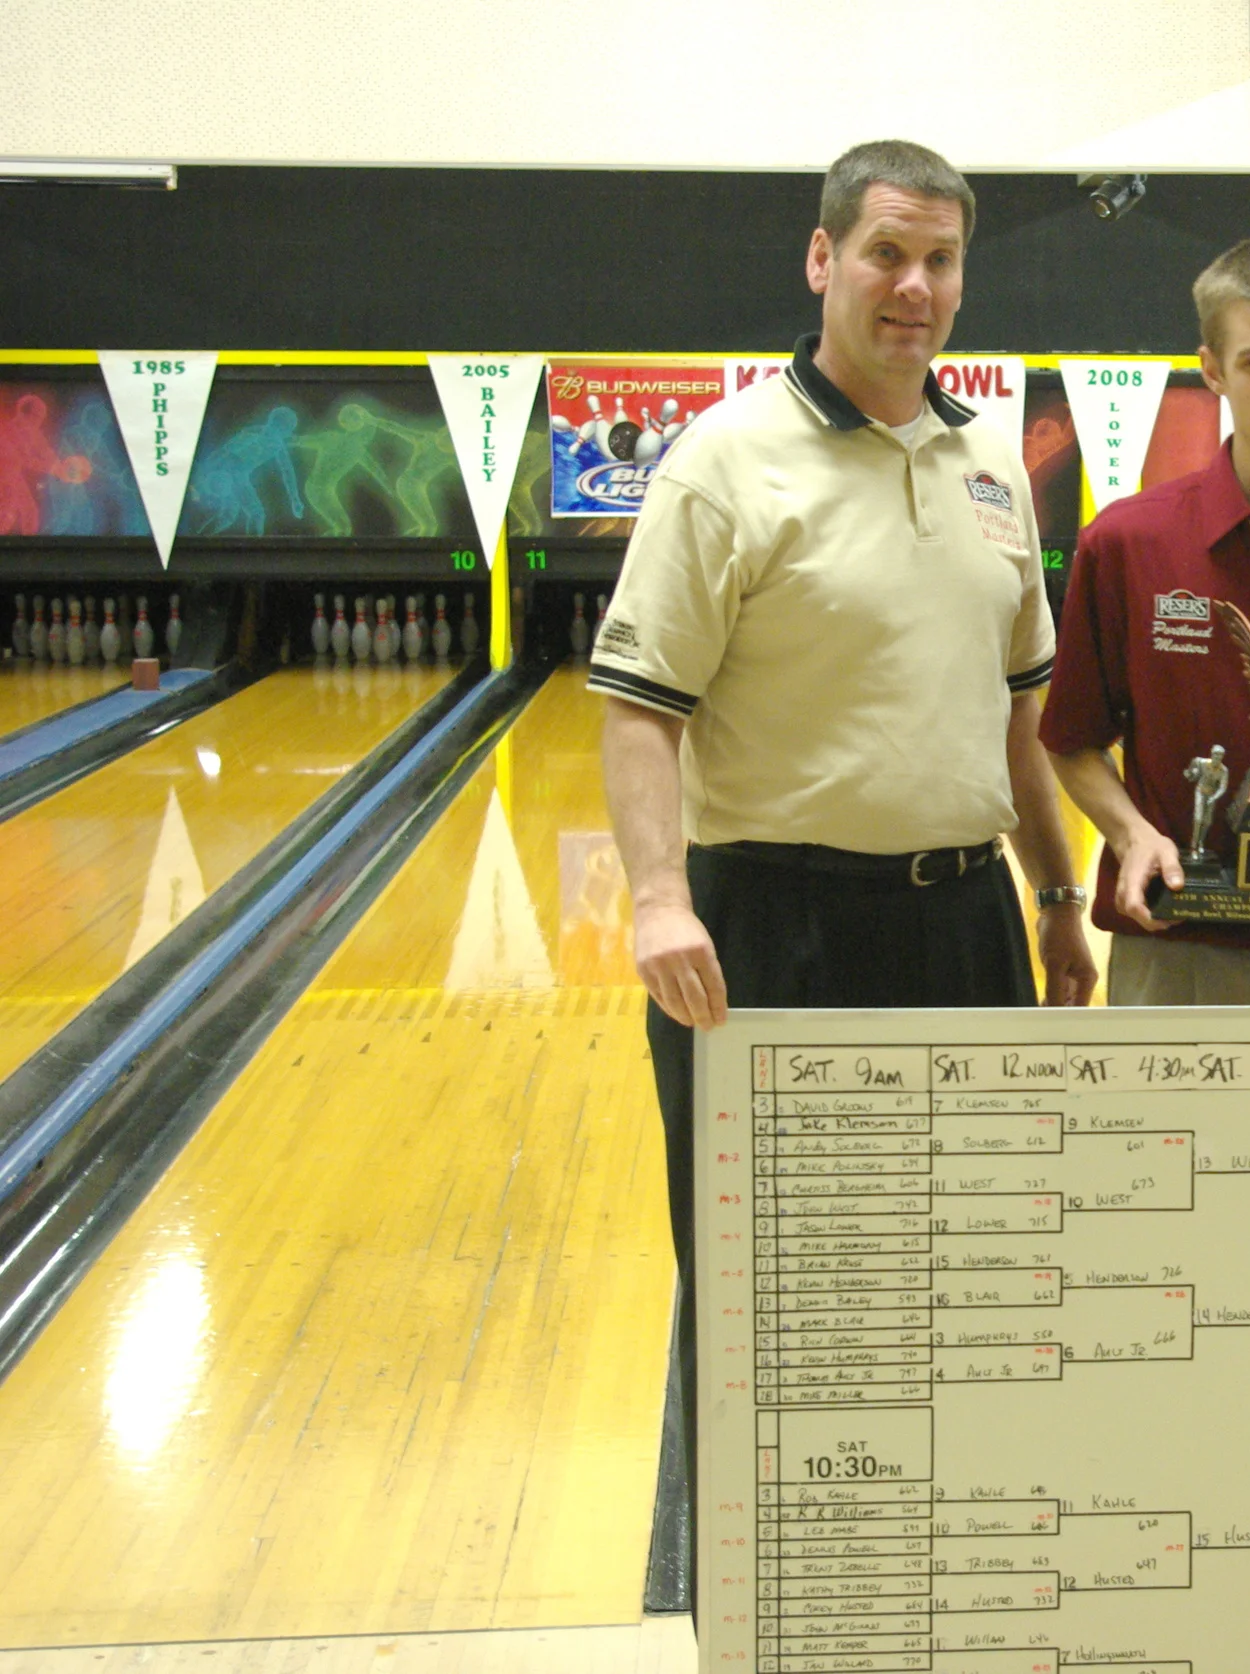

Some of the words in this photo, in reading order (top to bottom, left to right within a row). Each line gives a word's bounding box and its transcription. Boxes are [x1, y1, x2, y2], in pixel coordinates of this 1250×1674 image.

[132, 360, 186, 375] 1985
[462, 365, 510, 378] 2005
[937, 364, 1014, 398] OWL
[1087, 369, 1143, 387] 2008
[586, 380, 721, 396] BUDWEISER
[152, 382, 169, 477] PHIPPS
[480, 387, 497, 482] BAILEY
[1106, 402, 1123, 486] LOWER
[610, 468, 654, 482] BU
[590, 483, 647, 498] LIG
[975, 509, 1019, 534] Portland
[451, 551, 476, 571] 10
[526, 551, 546, 570] 11
[1041, 550, 1063, 569] 12
[1198, 1156, 1213, 1170] 13
[933, 1179, 946, 1193] 11
[958, 1178, 997, 1190] WEST
[1068, 1196, 1084, 1209] 10
[1095, 1193, 1134, 1207] WEST
[934, 1219, 949, 1233] 12
[935, 1255, 950, 1269] 15
[1196, 1308, 1211, 1325] 14
[760, 1372, 773, 1385] 17
[837, 1441, 868, 1453] SAT
[1062, 1499, 1074, 1514] 11
[936, 1523, 950, 1536] 10
[1195, 1533, 1210, 1547] 15
[934, 1560, 948, 1574] 13
[1063, 1575, 1077, 1590] 12
[934, 1597, 949, 1611] 14
